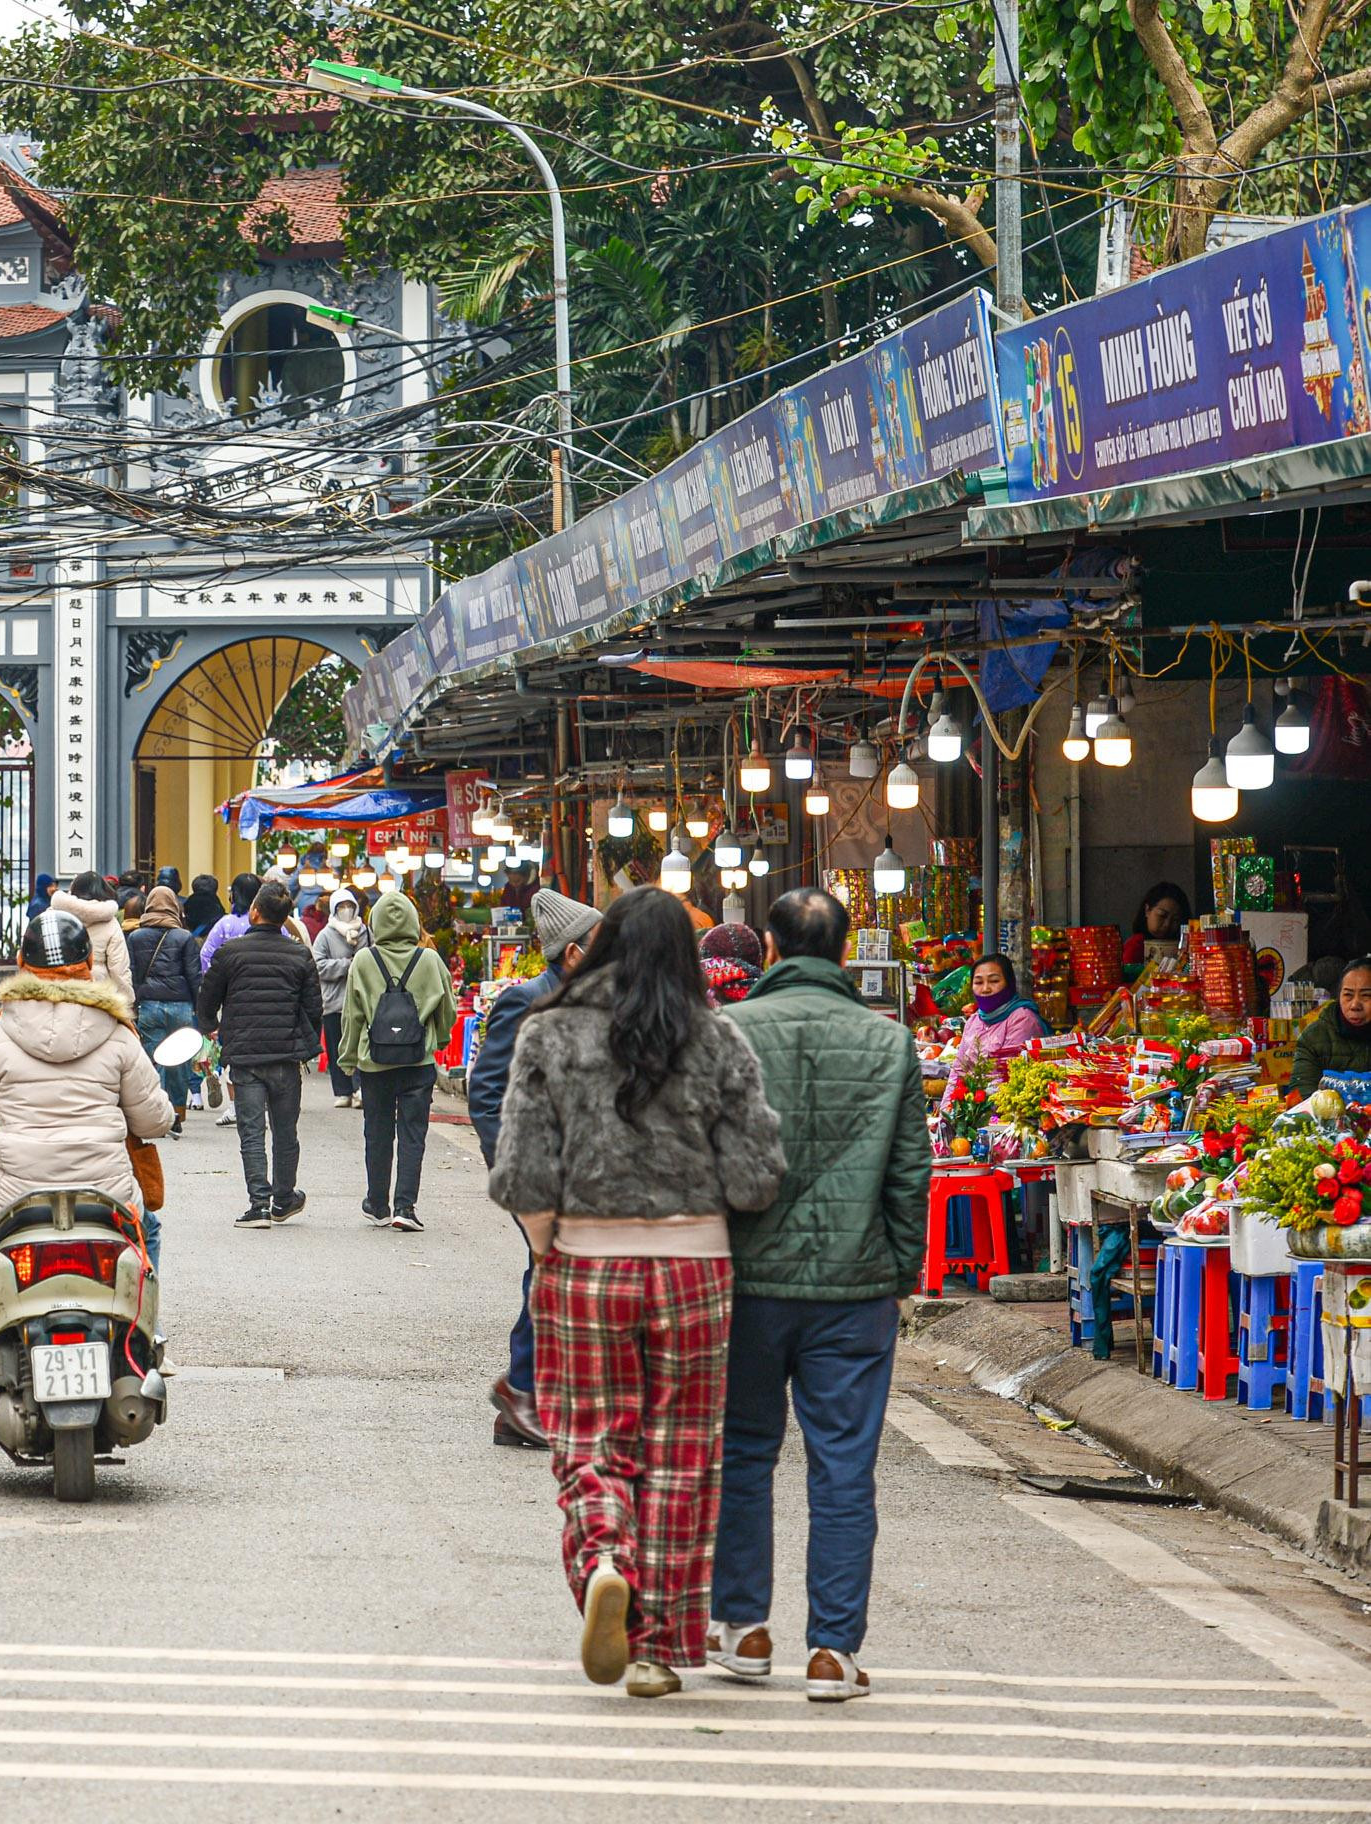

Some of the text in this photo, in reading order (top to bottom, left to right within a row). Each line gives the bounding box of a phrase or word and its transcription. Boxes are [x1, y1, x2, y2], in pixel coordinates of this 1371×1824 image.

[1099, 303, 1197, 405] MINH HÙNG
[1222, 278, 1252, 354] VIẾT
[1249, 277, 1273, 347] SỚ
[949, 318, 988, 407] LUYẾN
[1228, 364, 1288, 431] CHỮ NHO
[1056, 353, 1081, 454] 15
[44, 1347, 96, 1372] 29-Y1
[46, 1373, 98, 1397] 2131
